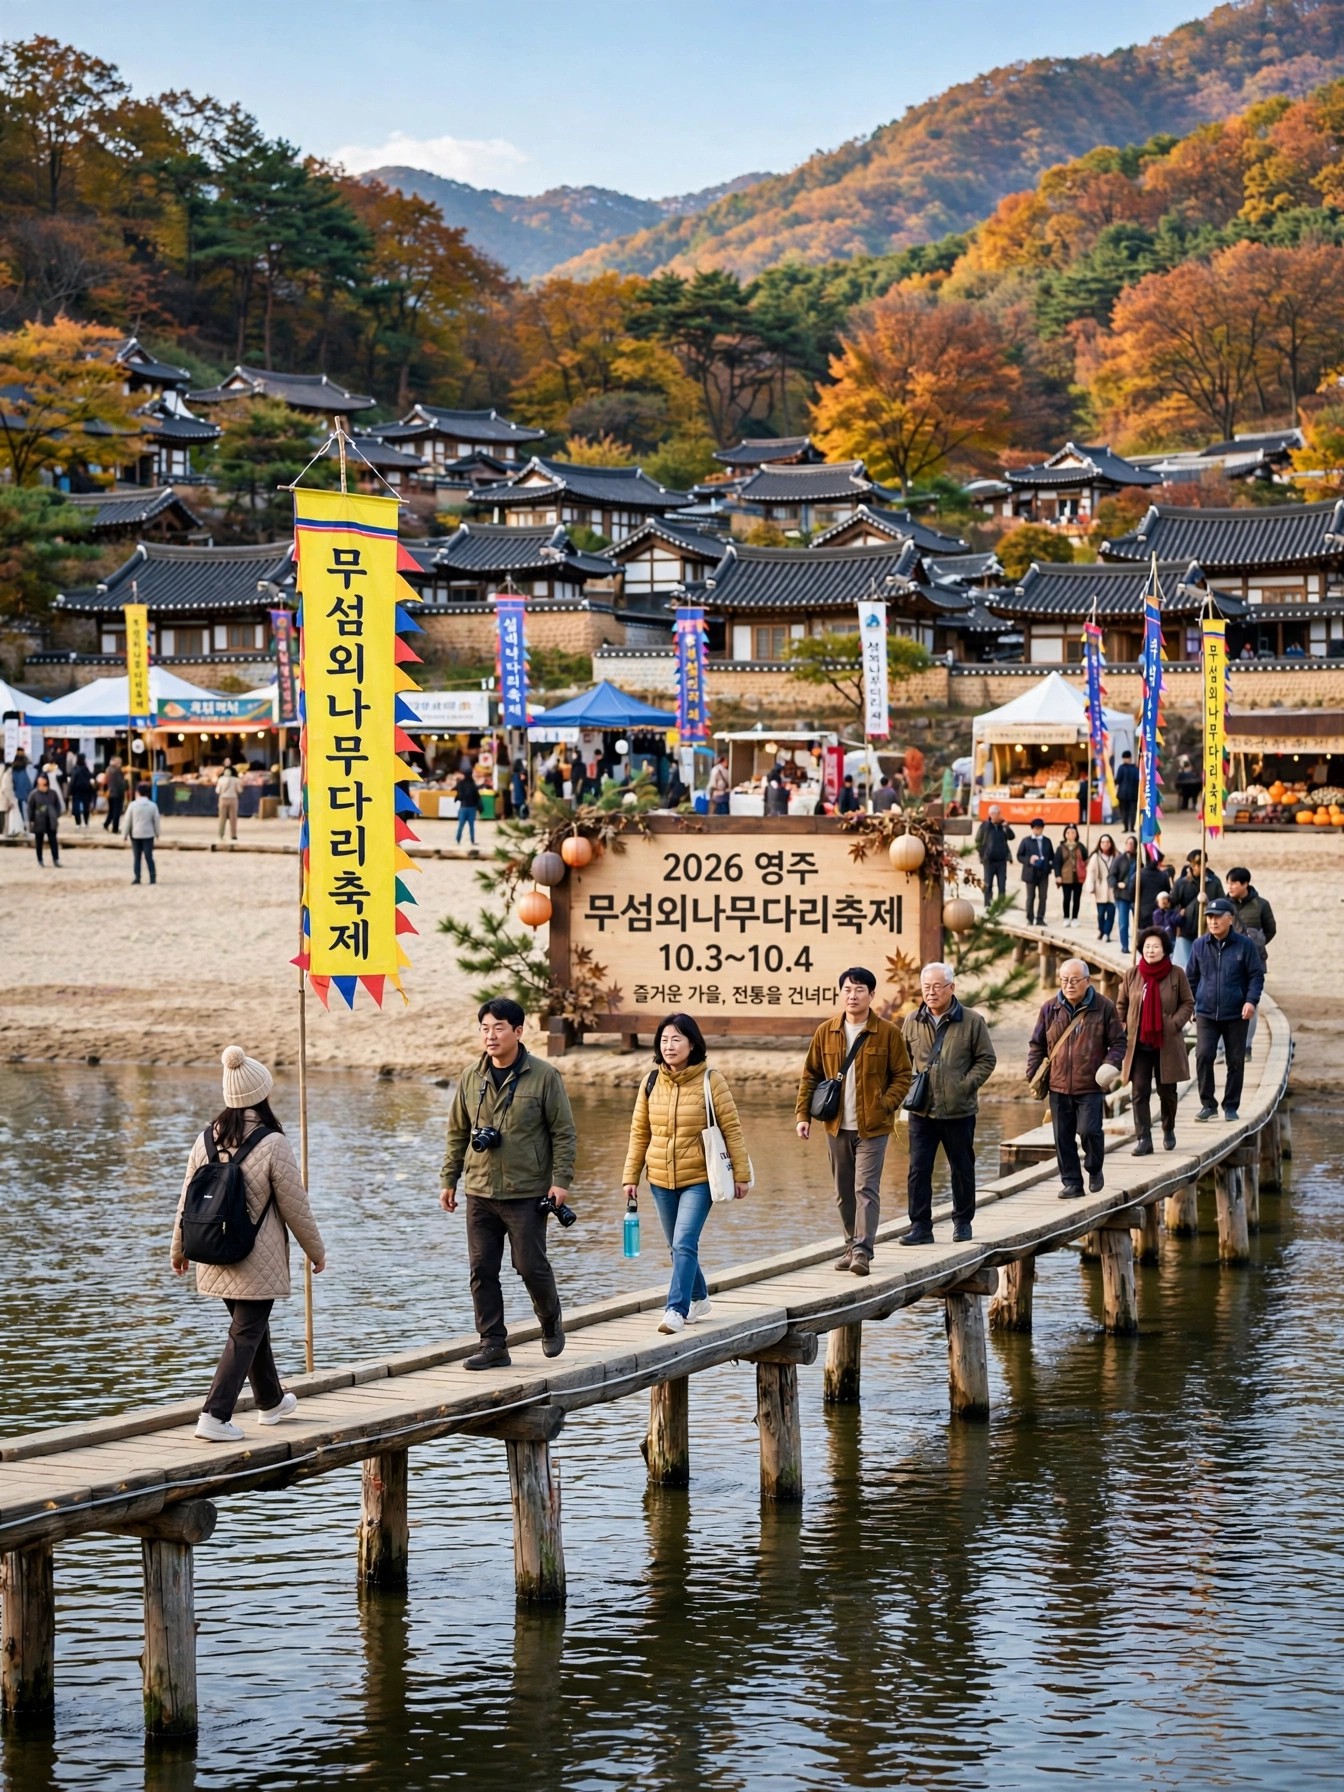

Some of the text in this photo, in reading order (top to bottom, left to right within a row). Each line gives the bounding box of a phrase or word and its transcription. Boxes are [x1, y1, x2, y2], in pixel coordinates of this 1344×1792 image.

[325, 547, 373, 961] 무섬외나무다리축제
[663, 850, 819, 886] 2026 영주
[584, 893, 904, 935] 무섬외나무다리축제
[659, 943, 814, 973] 10.3~10.4
[633, 984, 839, 1006] 즐거운 가을, 전통을 건녀다
